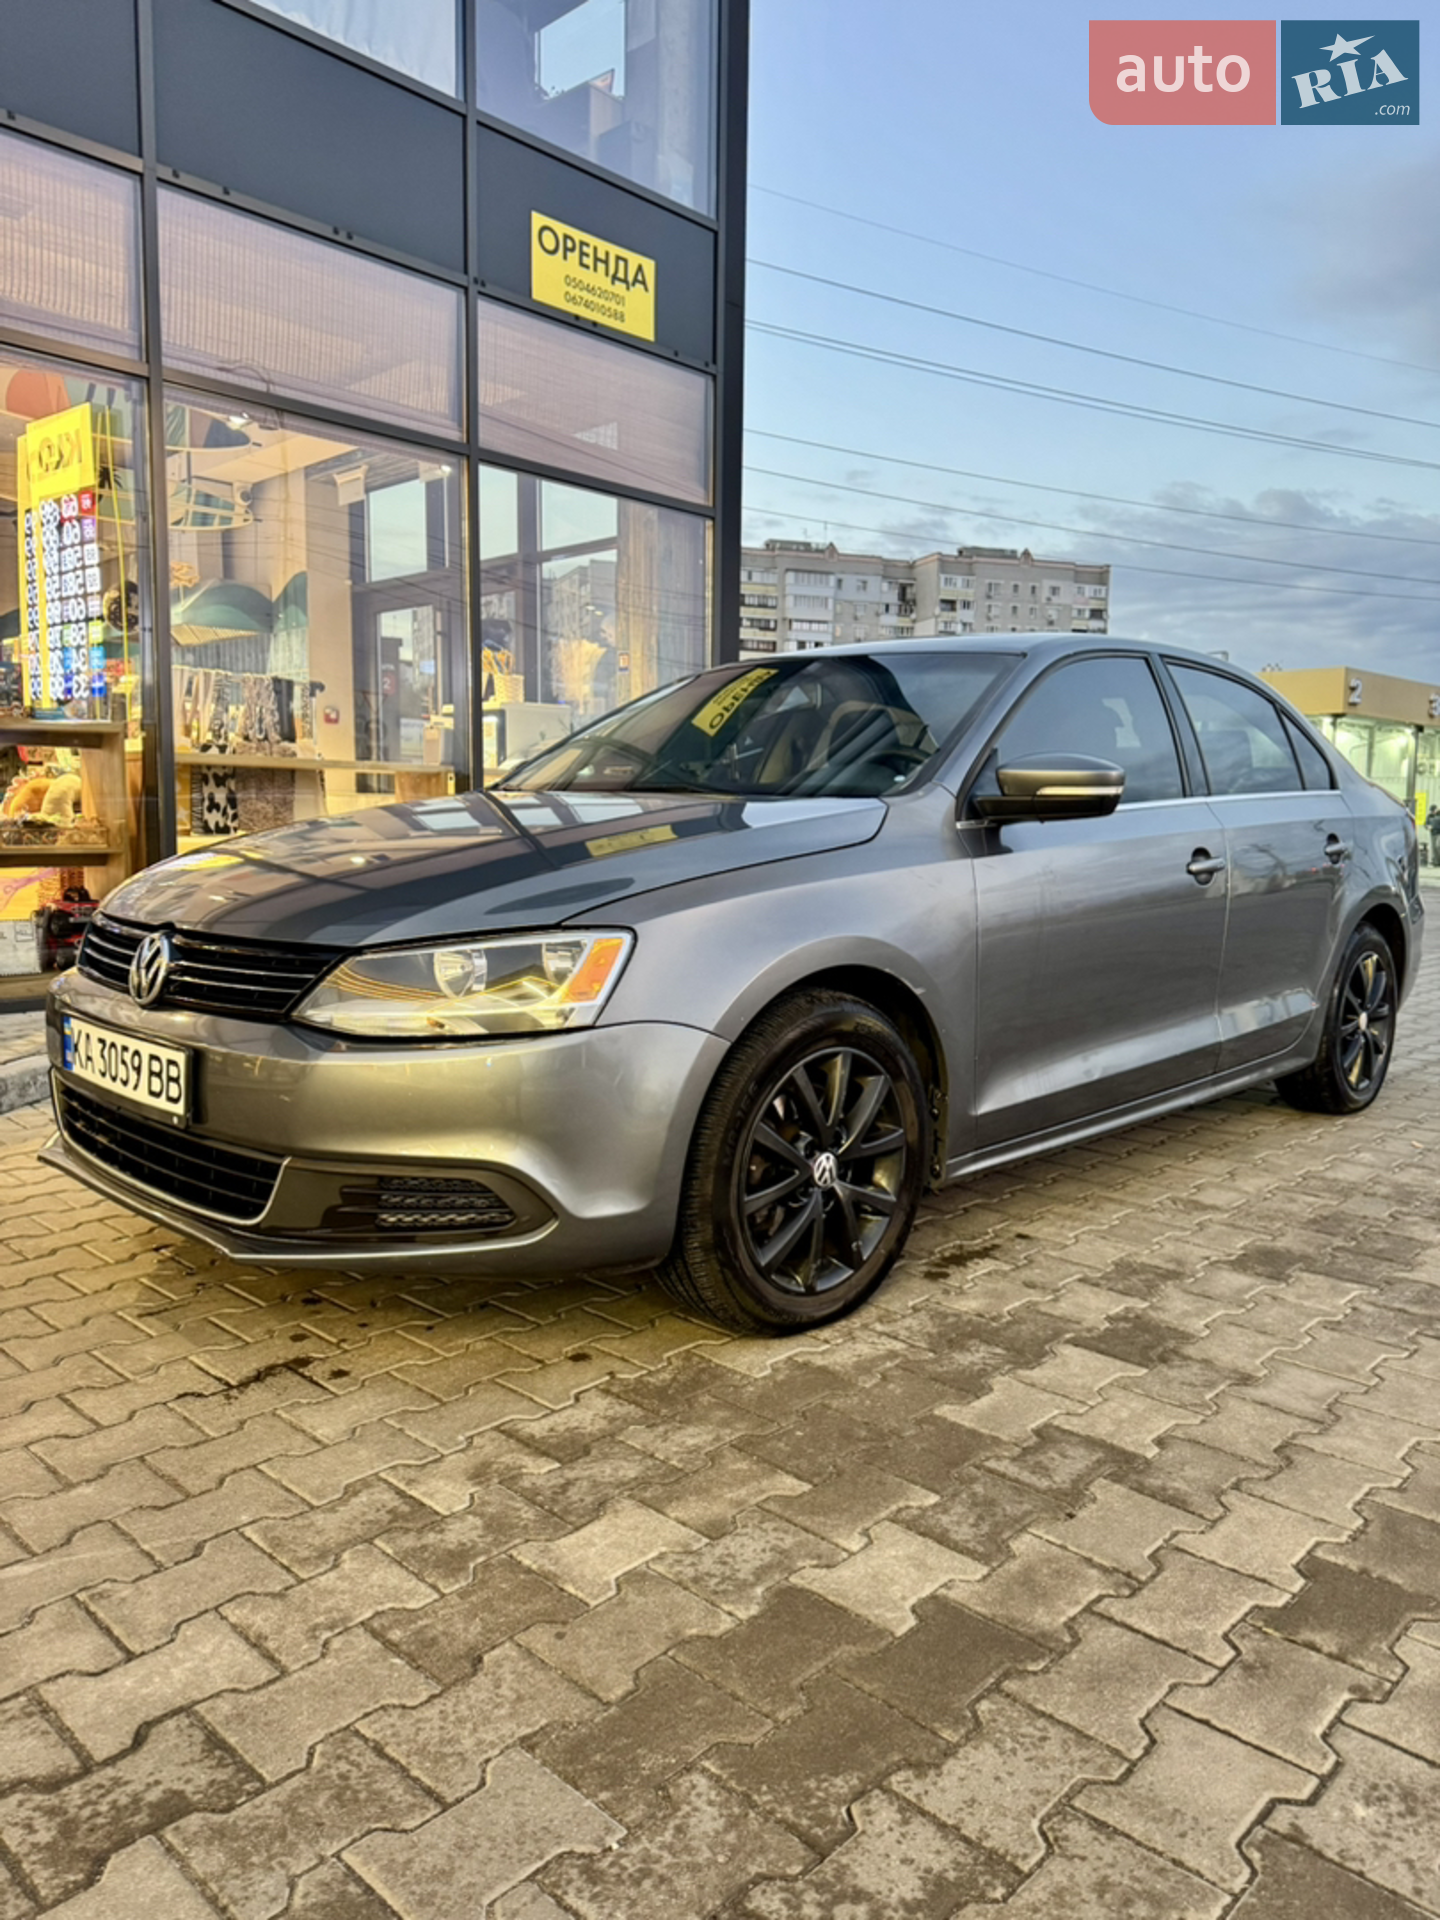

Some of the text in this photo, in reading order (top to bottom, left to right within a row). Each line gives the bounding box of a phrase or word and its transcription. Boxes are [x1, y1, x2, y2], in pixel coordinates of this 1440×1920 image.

[538, 224, 649, 293] ОРЕНДА
[564, 274, 626, 307] 0504620701
[1348, 678, 1362, 706] 2
